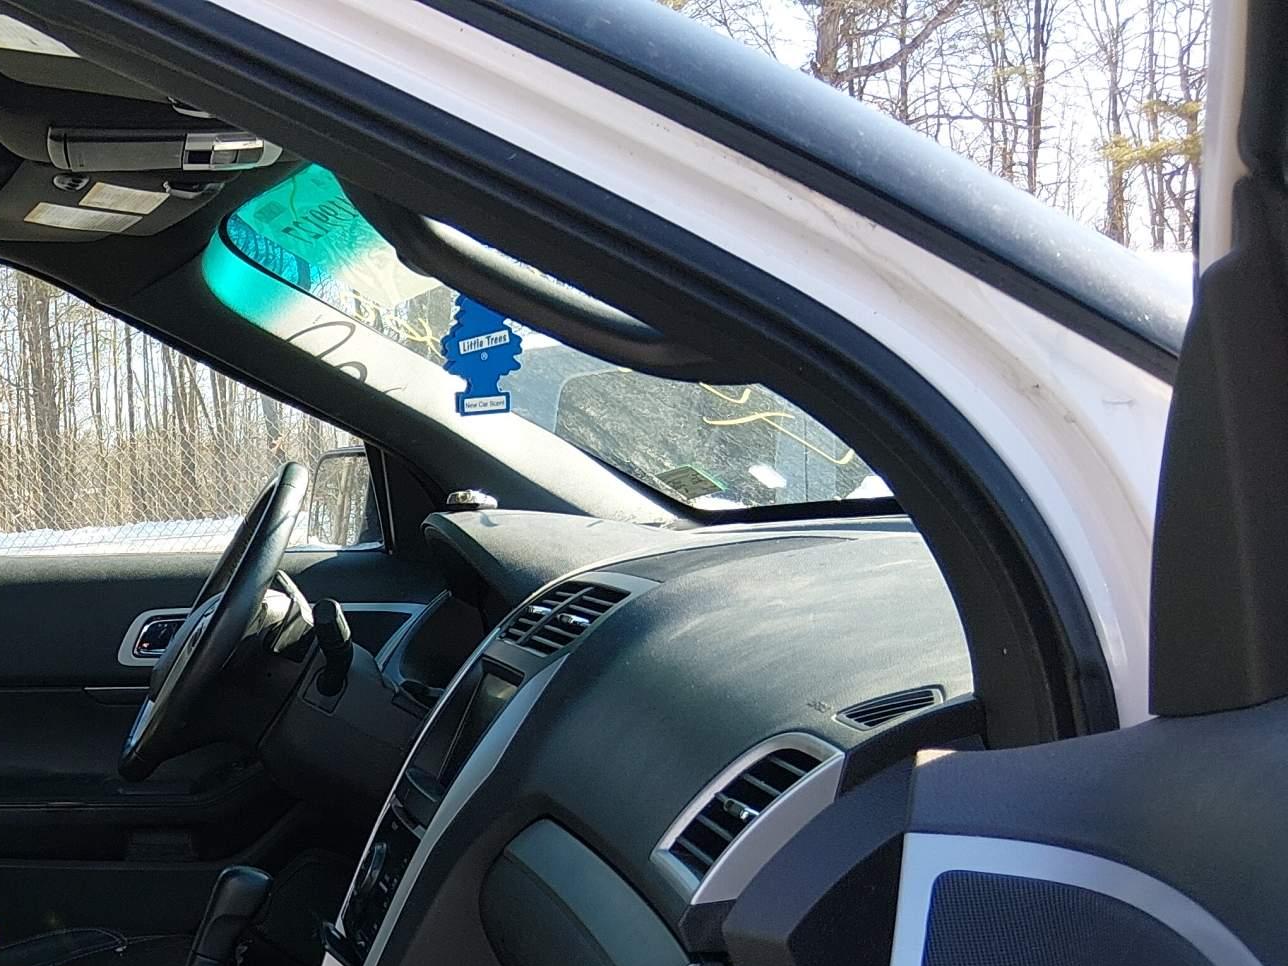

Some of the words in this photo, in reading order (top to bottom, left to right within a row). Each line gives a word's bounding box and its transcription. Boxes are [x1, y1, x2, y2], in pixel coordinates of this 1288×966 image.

[462, 339, 483, 352] Little
[485, 335, 507, 345] Trees
[489, 399, 505, 407] Scent
